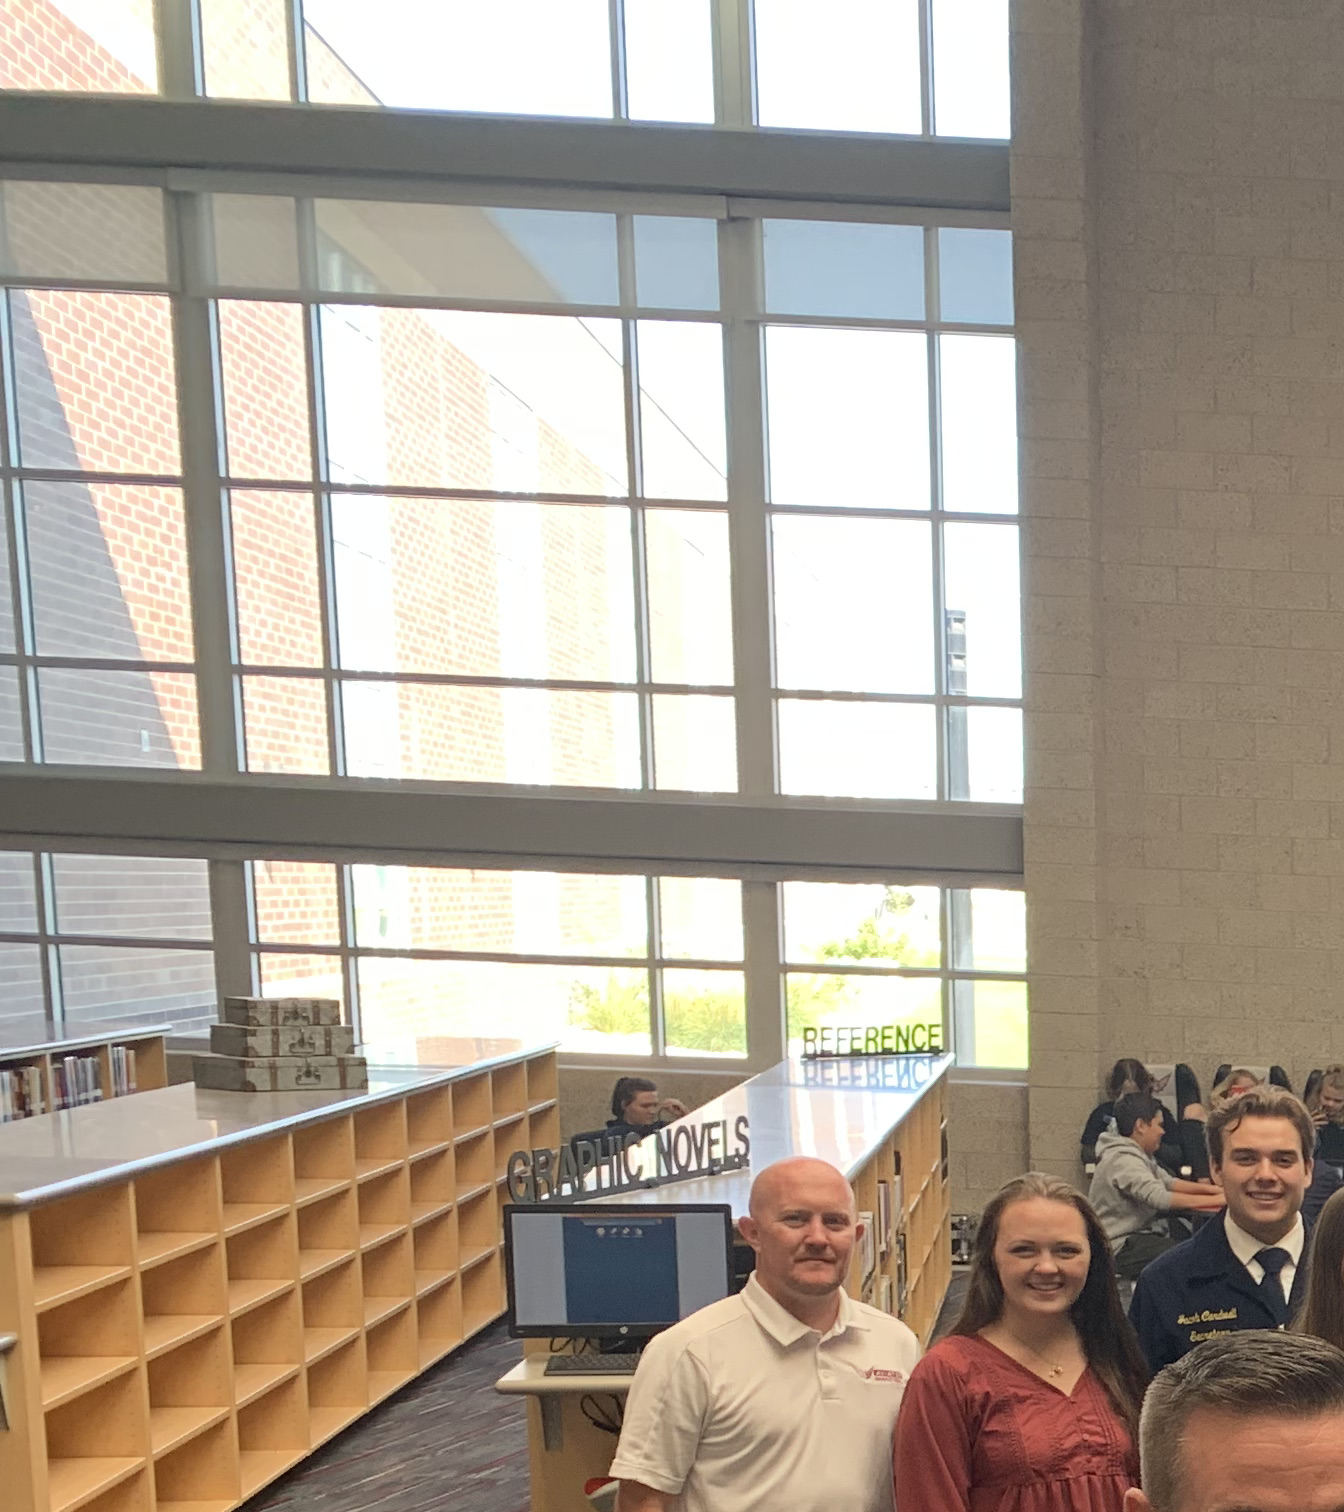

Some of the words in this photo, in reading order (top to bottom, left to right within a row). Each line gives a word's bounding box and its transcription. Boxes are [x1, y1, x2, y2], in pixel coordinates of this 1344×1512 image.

[803, 1023, 942, 1055] REFERENCE
[507, 1134, 645, 1203] GRAPHIC
[656, 1115, 750, 1177] NOVELS
